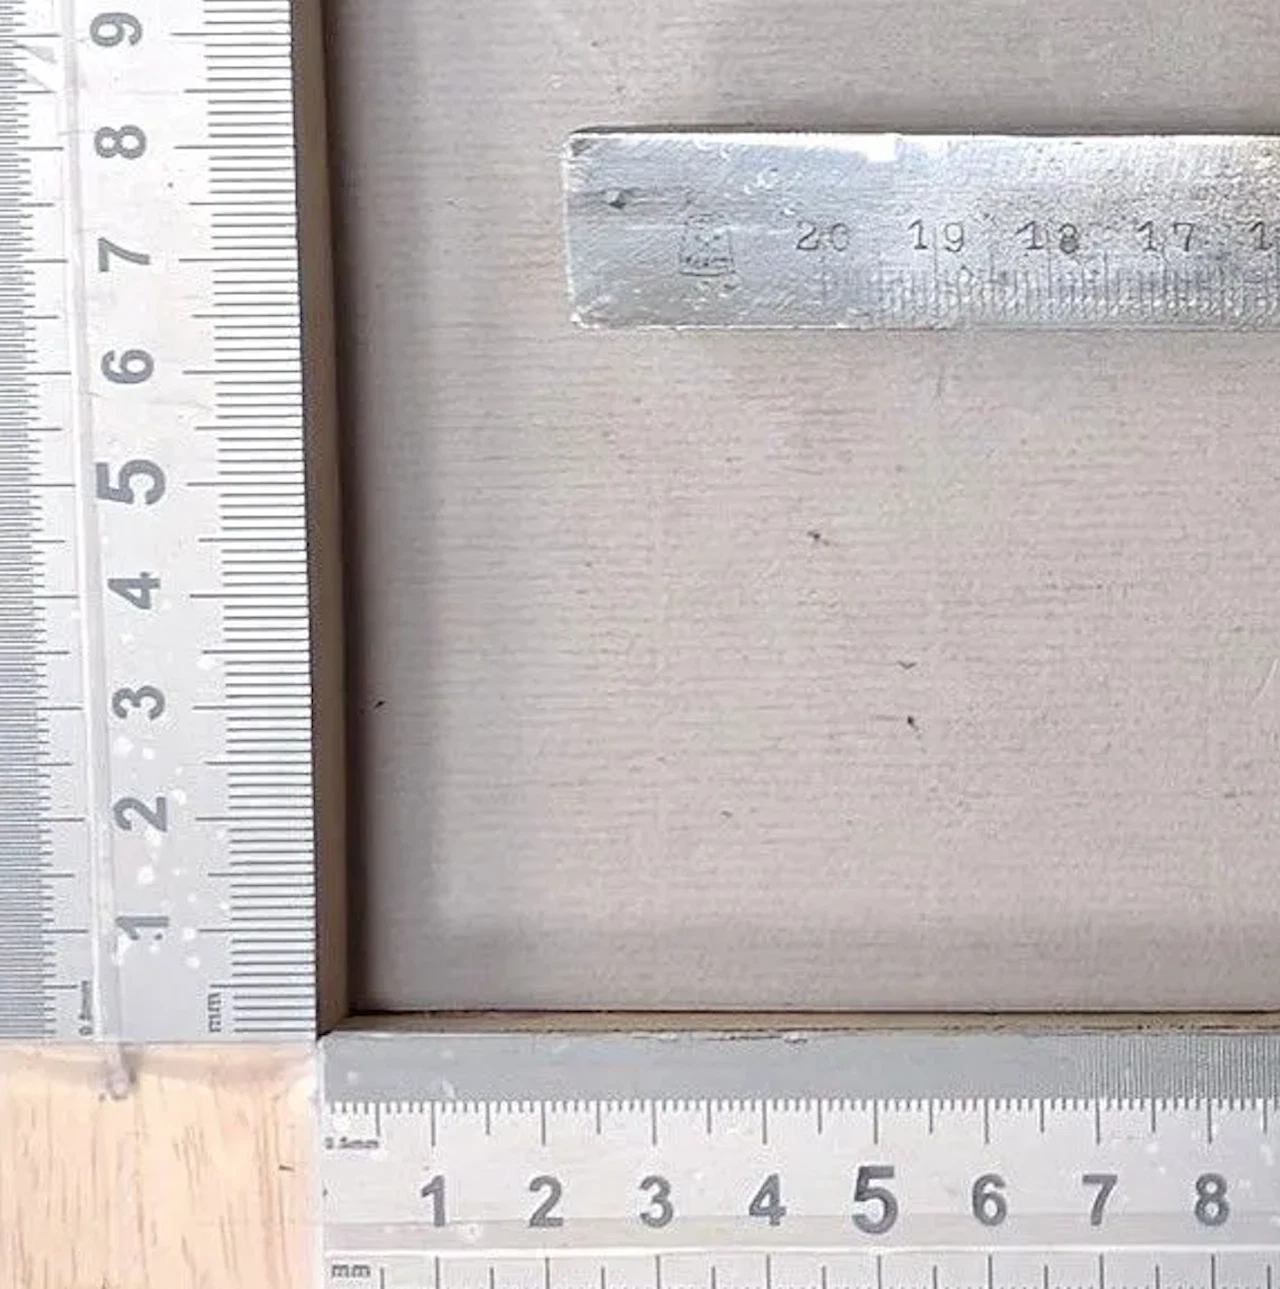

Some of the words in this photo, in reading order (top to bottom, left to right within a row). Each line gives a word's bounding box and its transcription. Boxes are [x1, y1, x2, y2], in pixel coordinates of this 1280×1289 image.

[89, 11, 143, 47] 9
[93, 124, 147, 161] 8
[99, 237, 150, 272] 7
[908, 219, 965, 253] 19
[1016, 221, 1080, 255] 18
[1138, 221, 1195, 254] 17
[100, 348, 155, 385] 6
[95, 459, 166, 507] 5
[107, 571, 160, 609] 4
[111, 685, 166, 722] 3
[112, 794, 168, 834] 2
[115, 915, 170, 942] 1
[207, 993, 222, 1033] mm
[420, 1175, 447, 1228] 1
[528, 1174, 562, 1228] 2
[640, 1175, 674, 1228] 3
[748, 1175, 786, 1227] 4
[852, 1165, 899, 1235] 5
[972, 1174, 1008, 1227] 6
[1082, 1174, 1118, 1226] 7
[1194, 1173, 1229, 1226] 8
[332, 1265, 370, 1277] mm
